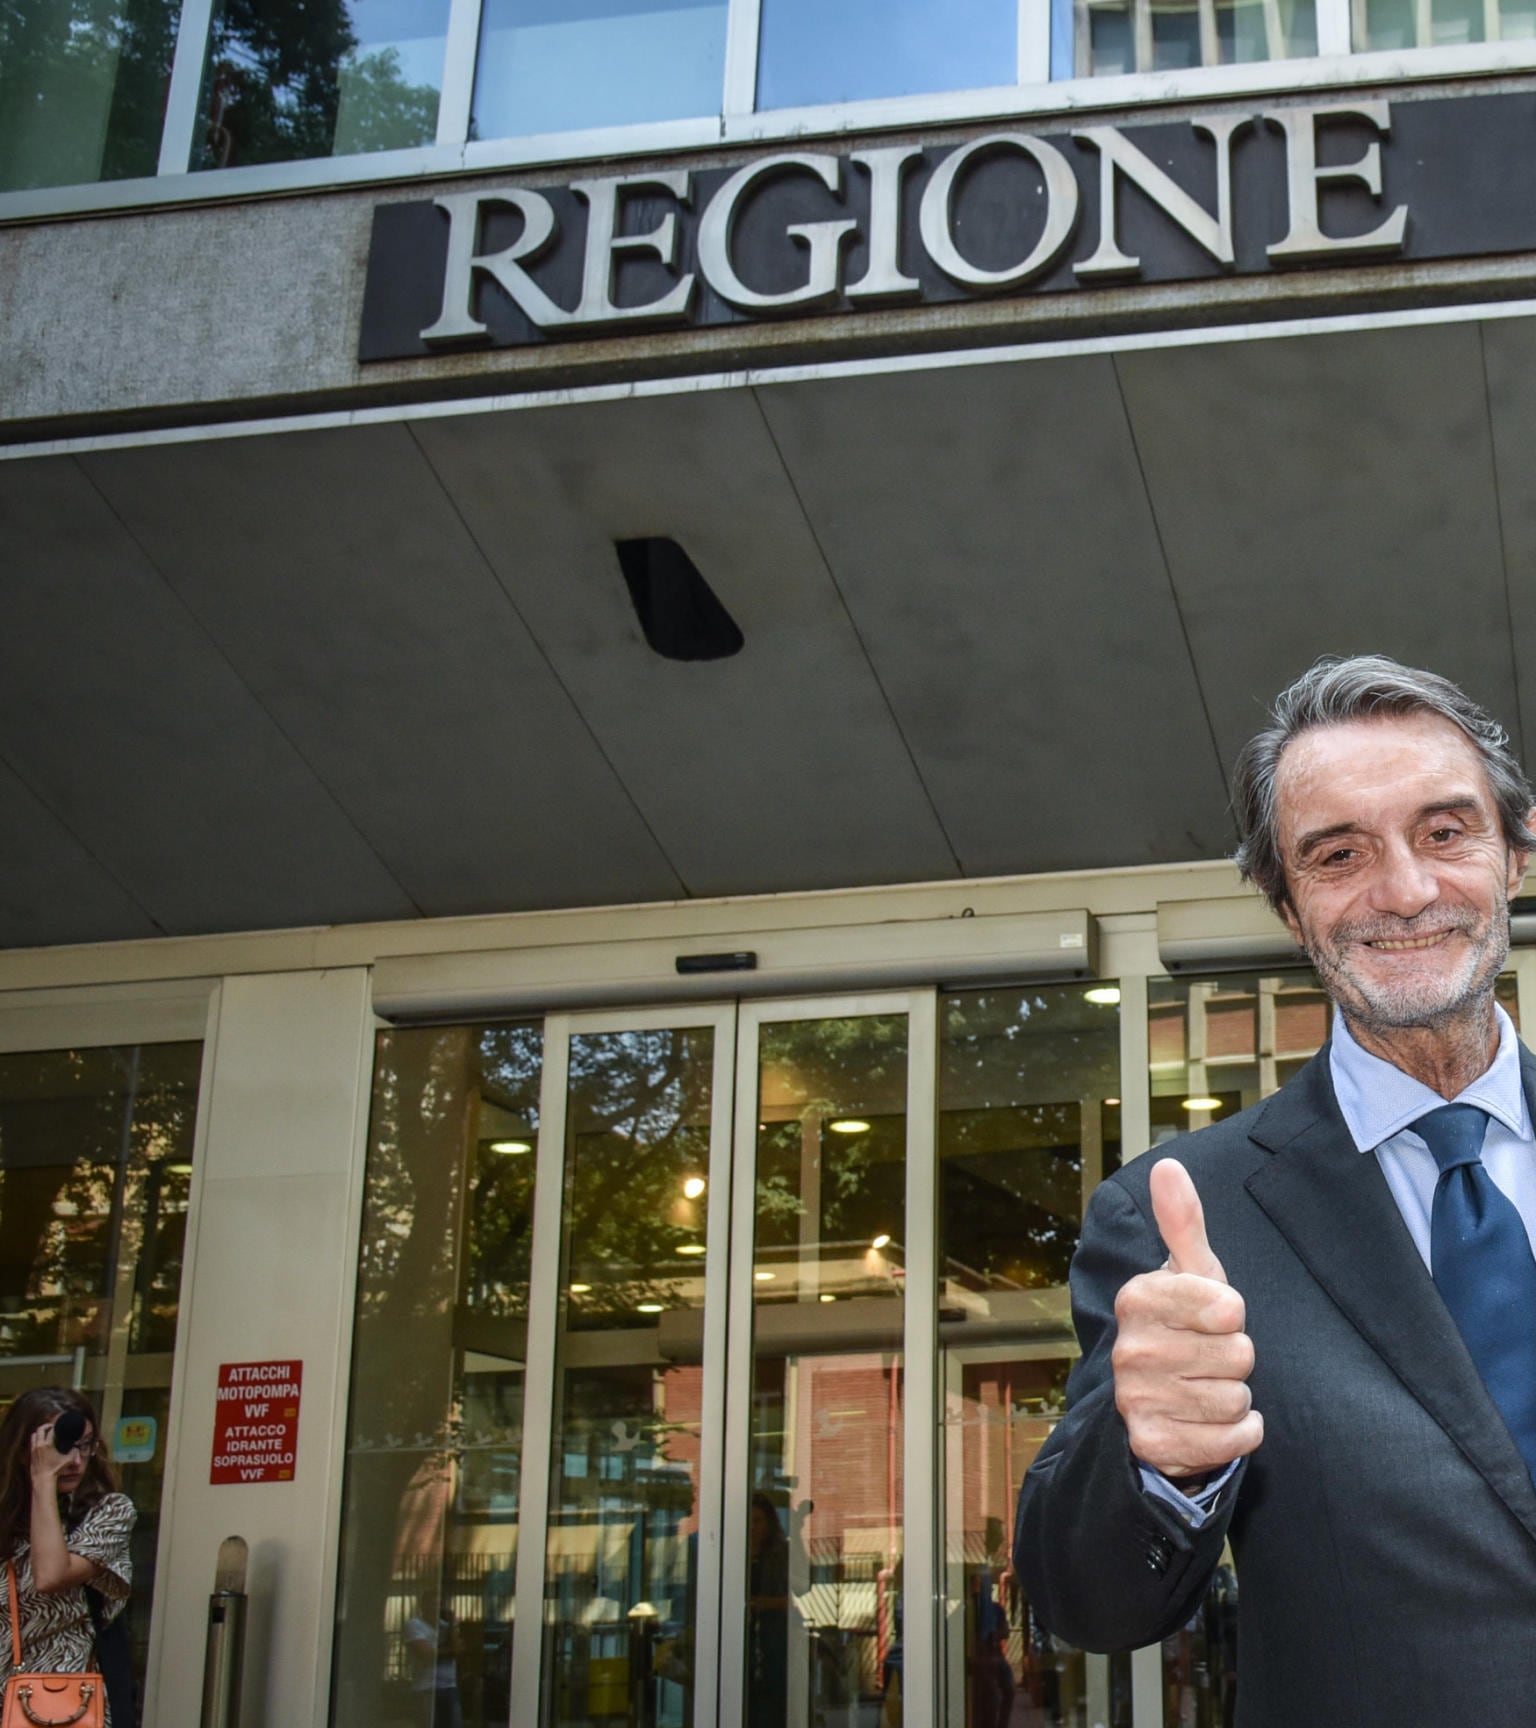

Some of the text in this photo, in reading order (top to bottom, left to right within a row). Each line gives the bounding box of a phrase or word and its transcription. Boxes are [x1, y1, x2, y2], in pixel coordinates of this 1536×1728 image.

[419, 98, 1410, 345] REGIONE
[229, 1366, 290, 1382] ATTACCHI
[216, 1383, 299, 1400] MOTOPOMPA
[244, 1403, 270, 1418] VVF
[226, 1424, 286, 1437] ATTACCO
[227, 1439, 283, 1451] IDRANTE
[213, 1452, 294, 1467] SOPRASUOLO
[240, 1468, 265, 1480] VVF
